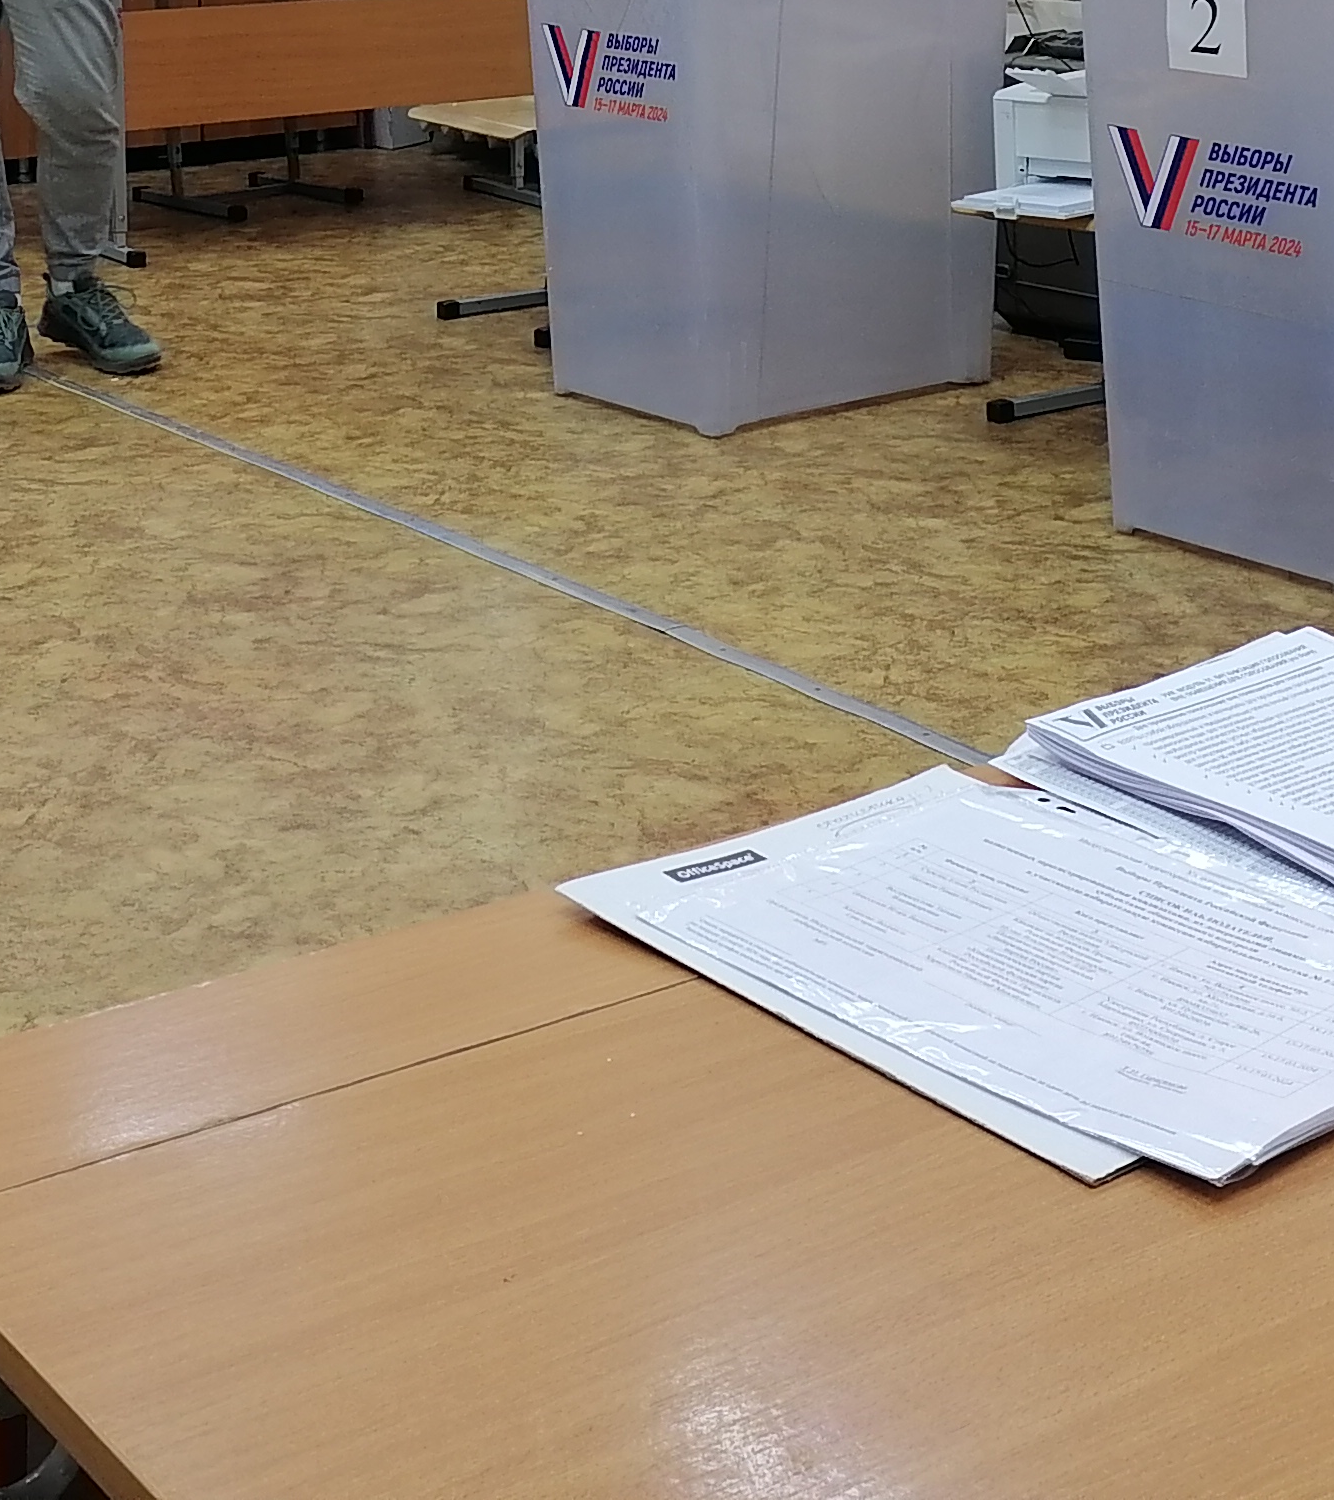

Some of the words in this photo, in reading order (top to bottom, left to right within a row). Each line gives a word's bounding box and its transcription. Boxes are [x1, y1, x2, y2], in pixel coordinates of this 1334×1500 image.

[606, 33, 660, 55] ВЫБОРЫ
[601, 55, 676, 81] ПРЕЗИДЕНТА
[597, 77, 645, 98] РОССИИ
[617, 100, 647, 119] МАРТА
[647, 105, 668, 122] 2024
[1208, 142, 1294, 174] ВЫБОРЫ
[1200, 169, 1319, 208] ПРЕЗИДЕНТА
[1191, 194, 1266, 226] РОССИИ
[1222, 227, 1267, 251] МАРТА
[1269, 236, 1303, 258] 2024
[676, 852, 754, 880] OfficeSpace
